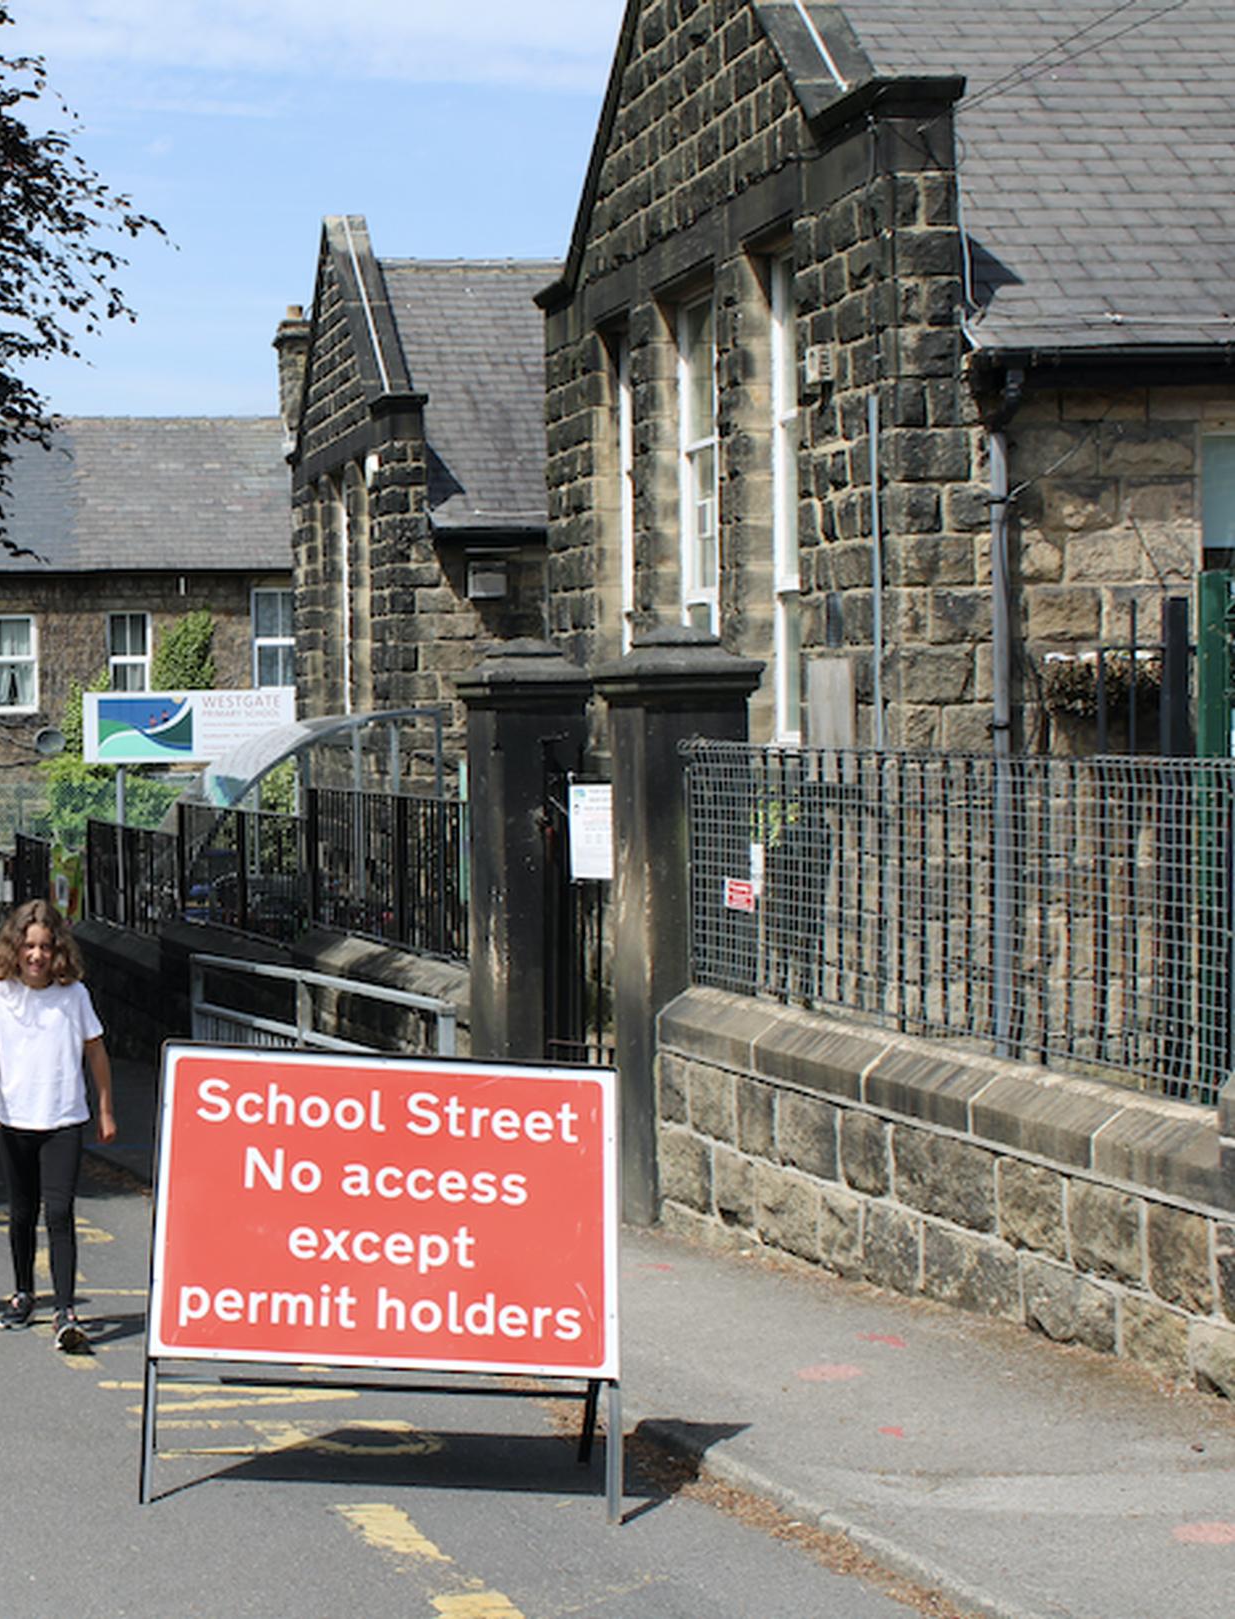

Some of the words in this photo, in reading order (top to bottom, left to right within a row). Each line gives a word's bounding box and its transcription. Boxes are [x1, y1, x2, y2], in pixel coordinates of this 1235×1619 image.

[201, 695, 281, 708] WESTGATE
[202, 709, 241, 717] PRIMARY
[244, 709, 280, 718] SCHOOL
[197, 1079, 385, 1132] School
[406, 1091, 579, 1143] Street
[243, 1146, 322, 1193] No
[341, 1163, 528, 1205] access
[288, 1226, 475, 1274] except
[178, 1284, 357, 1328] permit
[377, 1286, 582, 1340] holders
